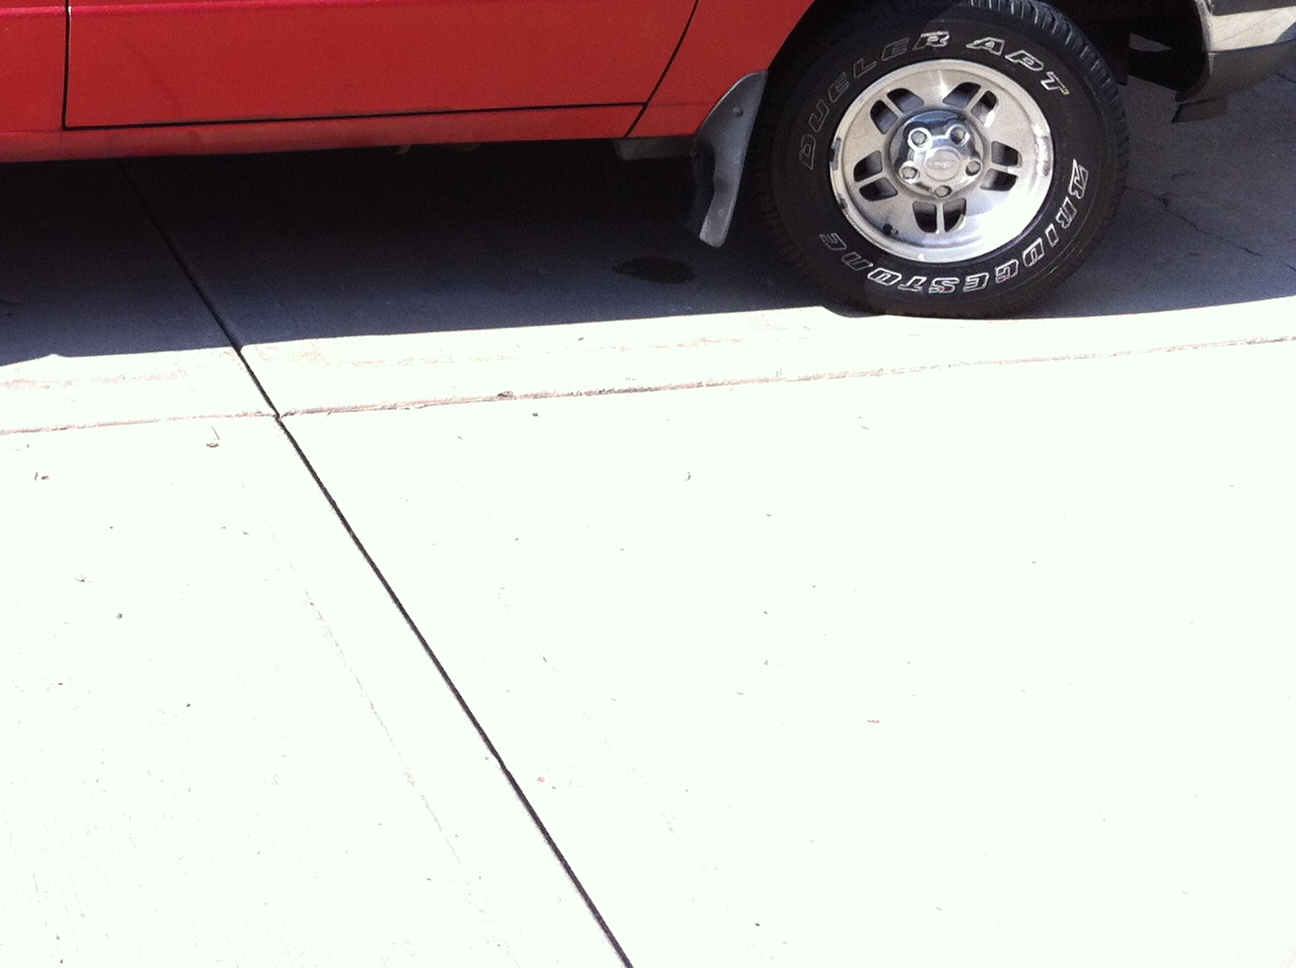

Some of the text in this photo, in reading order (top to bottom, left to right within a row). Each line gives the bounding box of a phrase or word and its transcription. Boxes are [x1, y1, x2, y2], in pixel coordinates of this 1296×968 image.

[797, 31, 1071, 170] DUELER APT
[818, 159, 1090, 294] BRIDGESTONE
